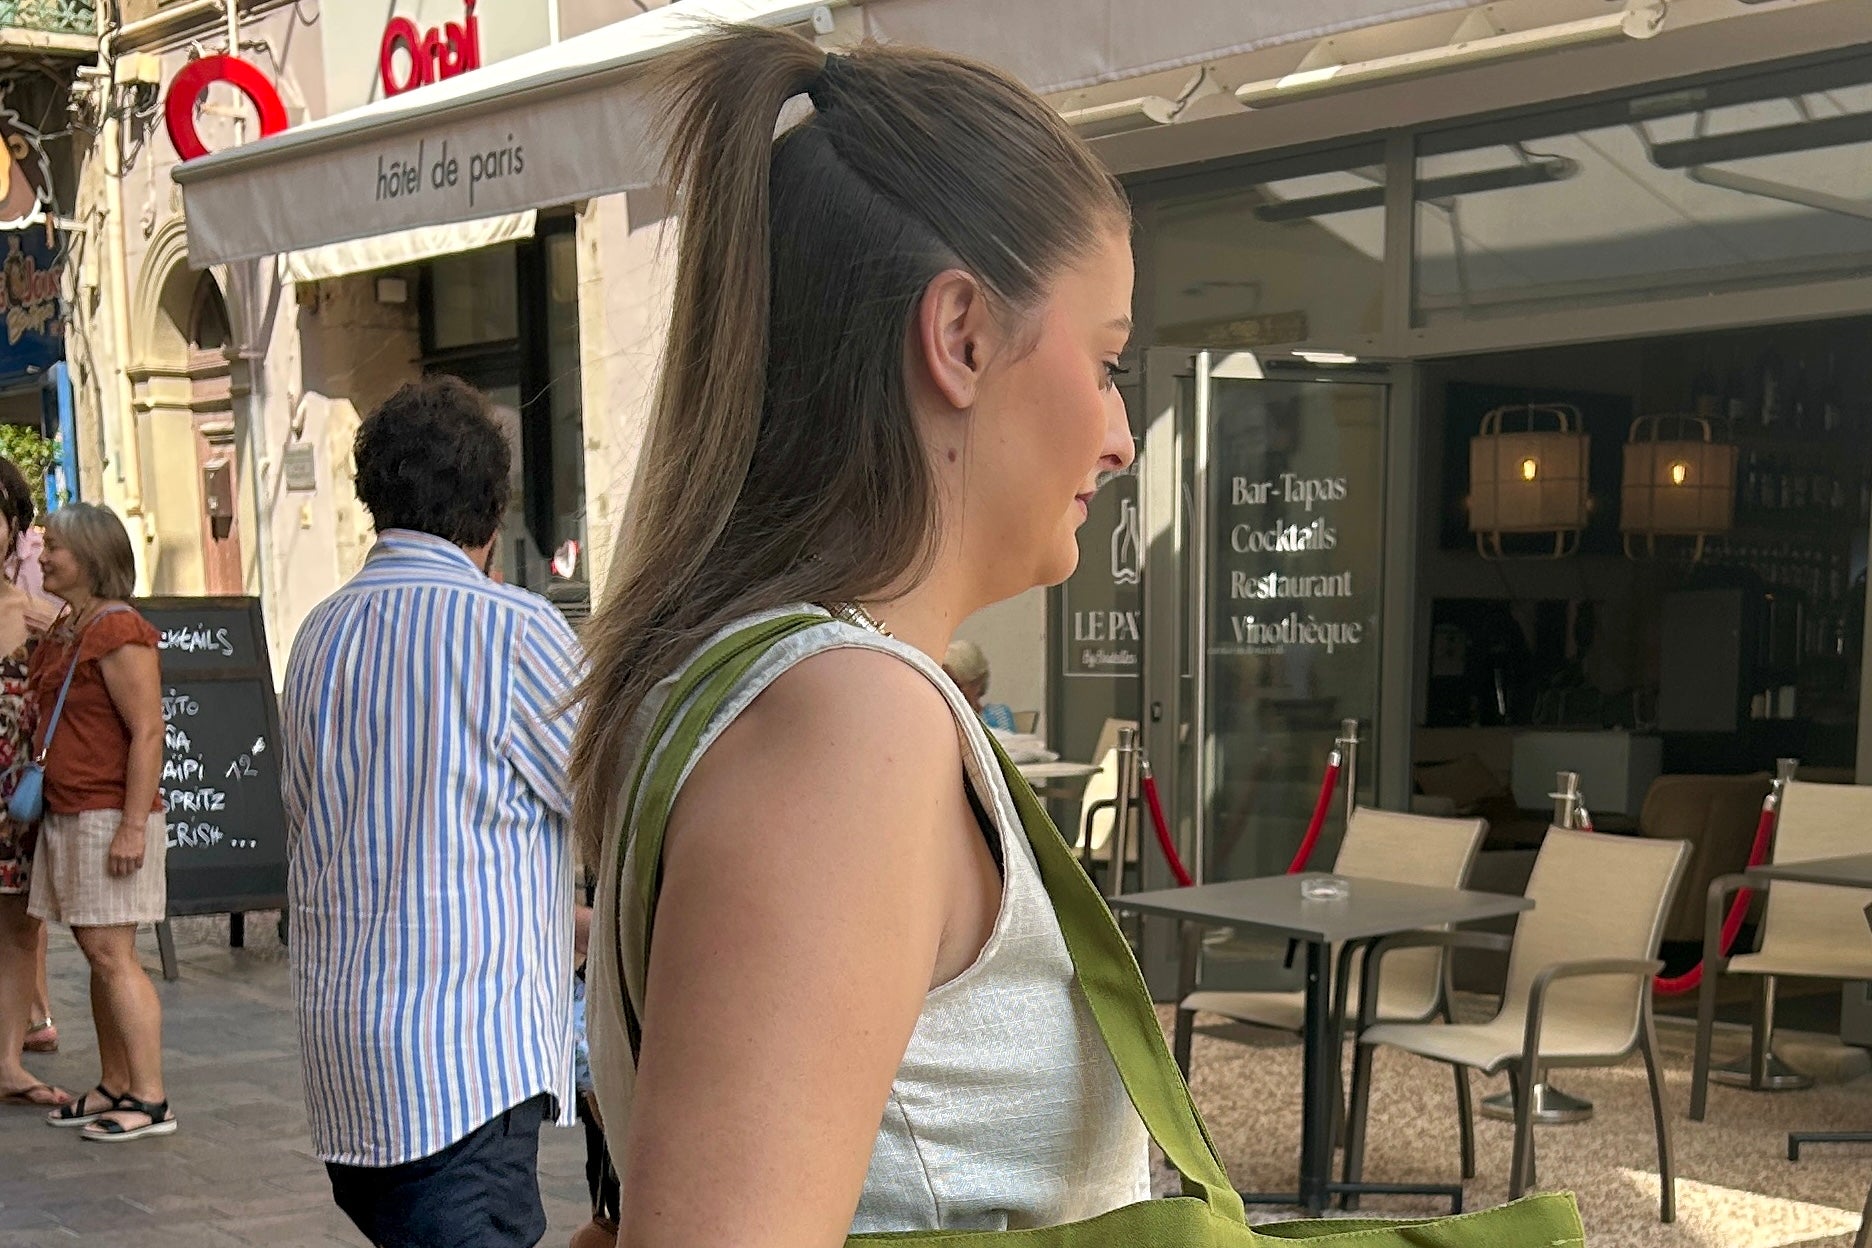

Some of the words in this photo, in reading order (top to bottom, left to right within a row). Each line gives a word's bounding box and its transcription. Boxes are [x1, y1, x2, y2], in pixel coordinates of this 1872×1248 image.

[376, 139, 424, 201] hôtel
[432, 140, 458, 190] de
[470, 133, 524, 207] paris
[1232, 473, 1348, 511] Bar-Tapas
[1231, 517, 1338, 553] Cocktails
[1231, 569, 1352, 599] Restaurant
[1074, 611, 1104, 641] LE
[1231, 612, 1362, 654] Vinothèque
